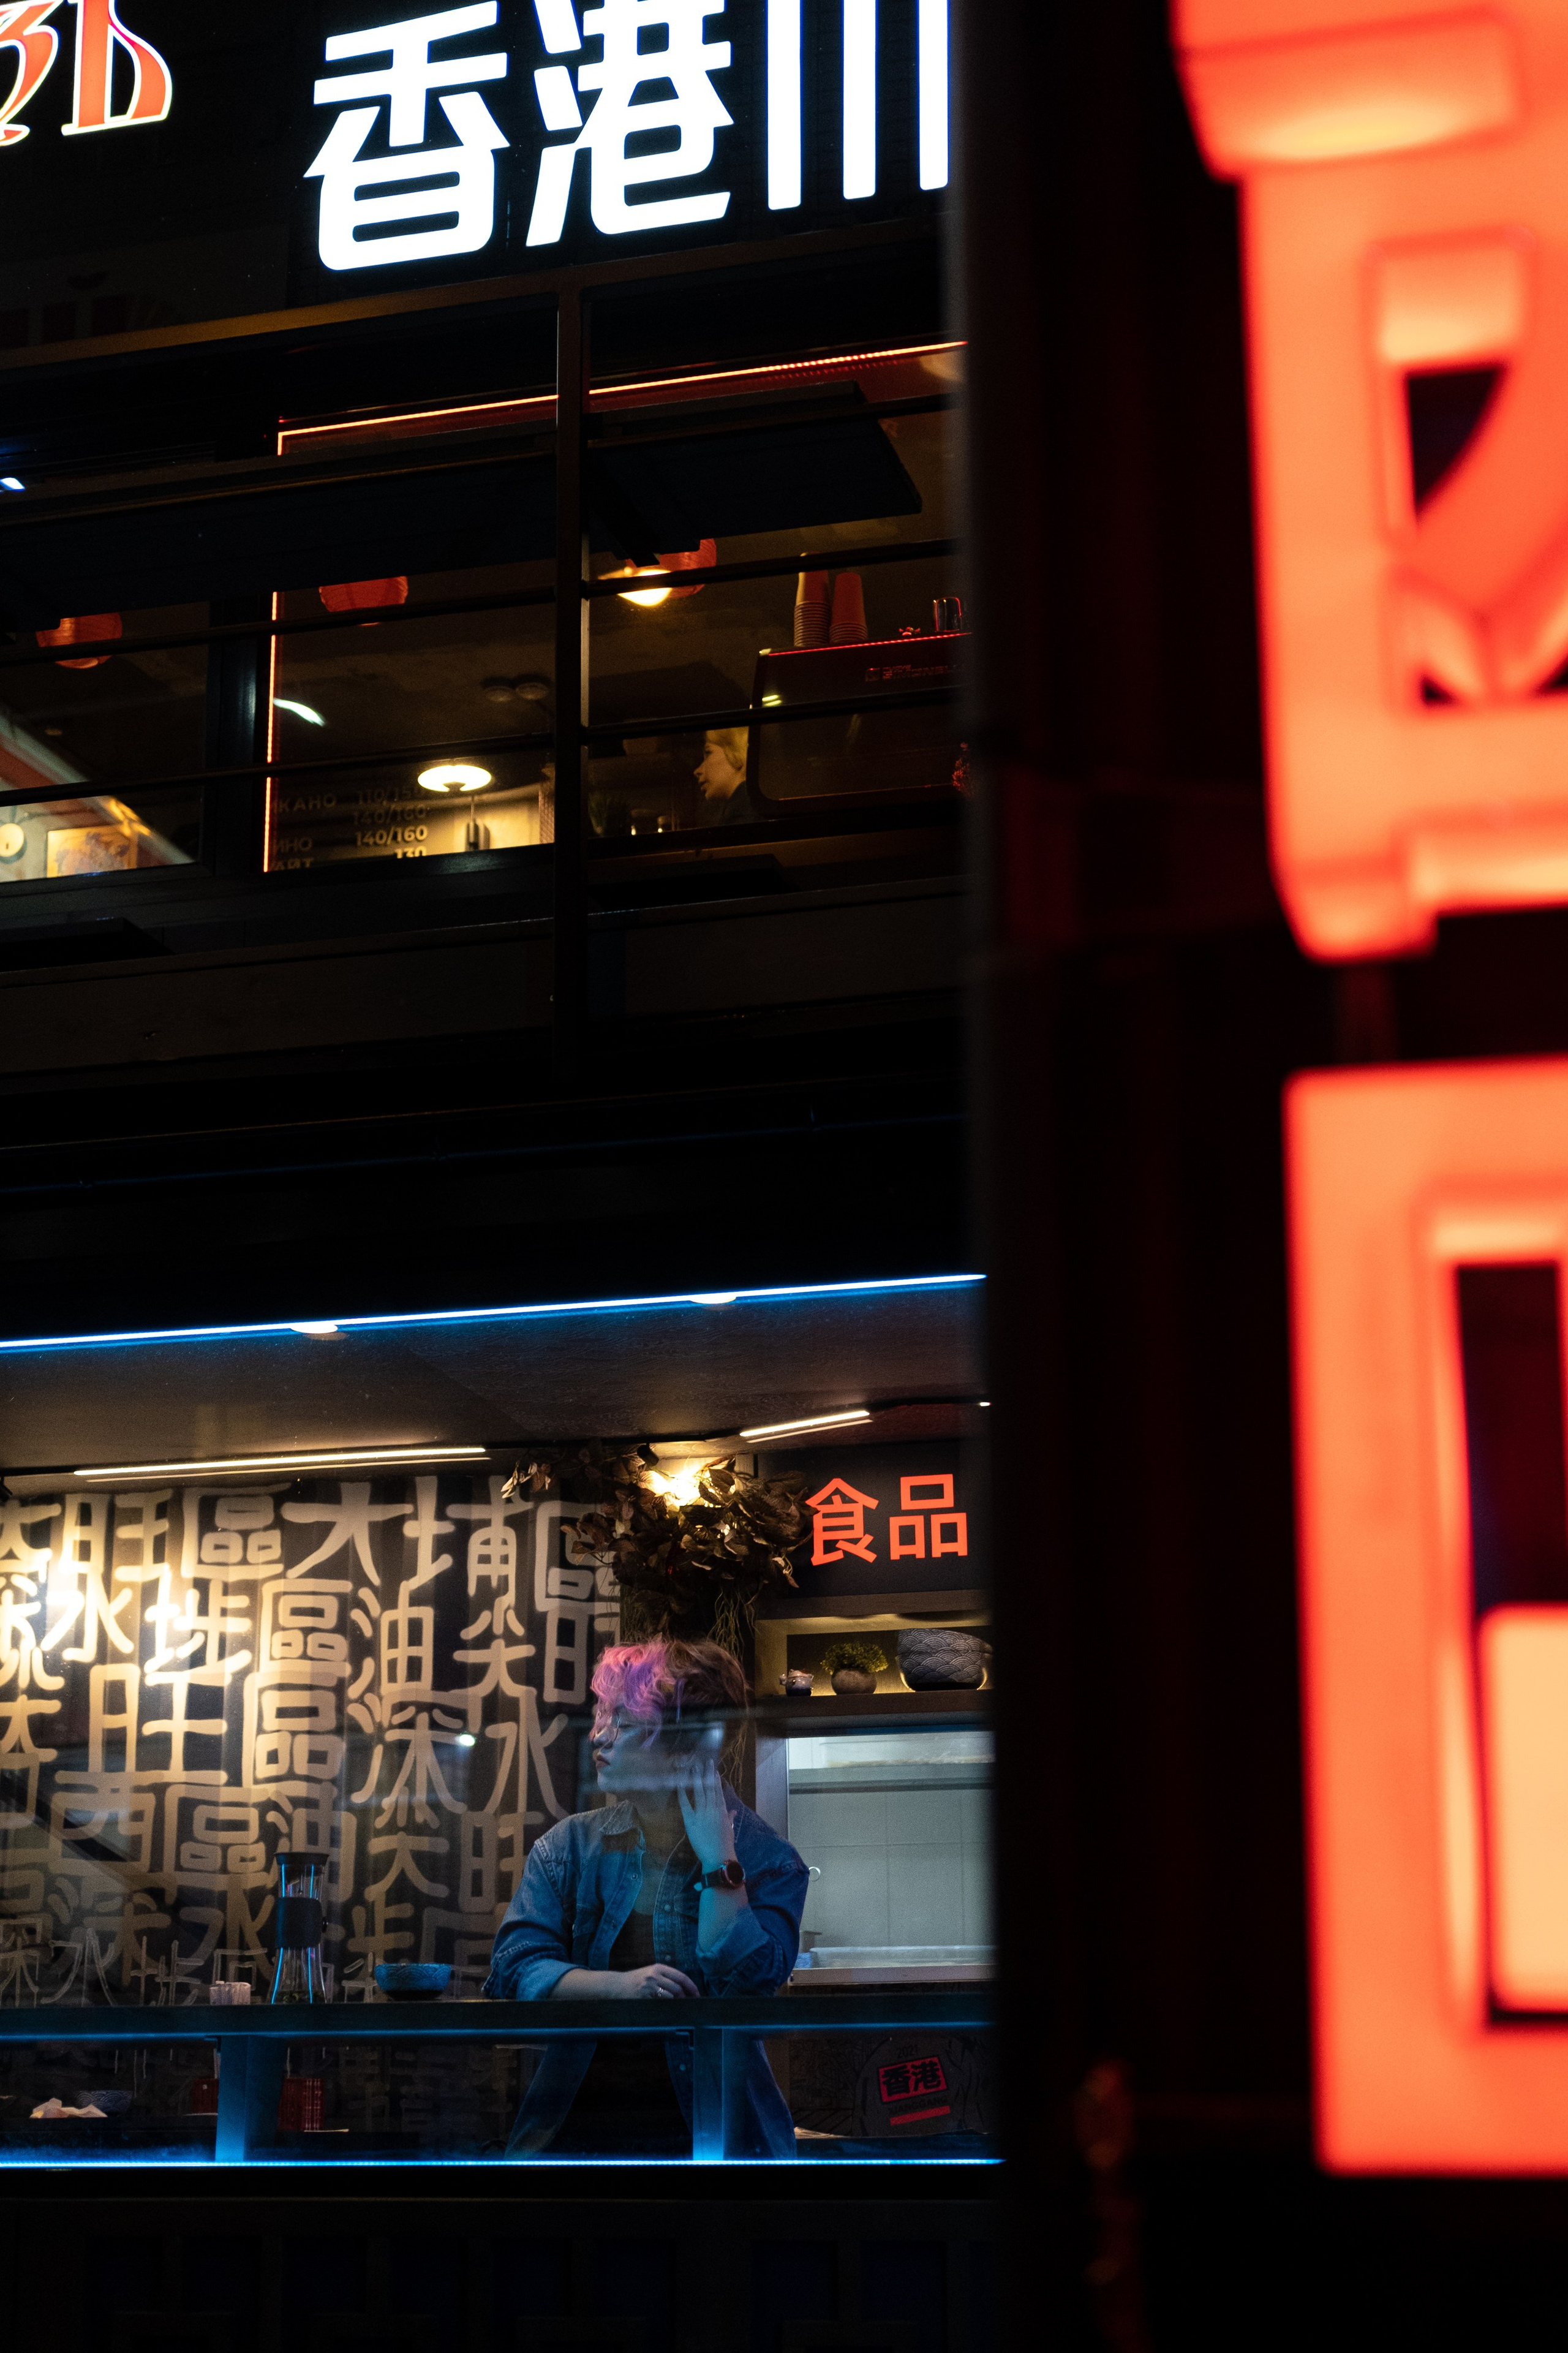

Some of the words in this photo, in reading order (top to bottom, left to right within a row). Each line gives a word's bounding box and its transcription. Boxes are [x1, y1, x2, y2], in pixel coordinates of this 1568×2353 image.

[355, 825, 428, 847] 140/160
[805, 1473, 968, 1566] 食品
[883, 2060, 941, 2096] 香港
